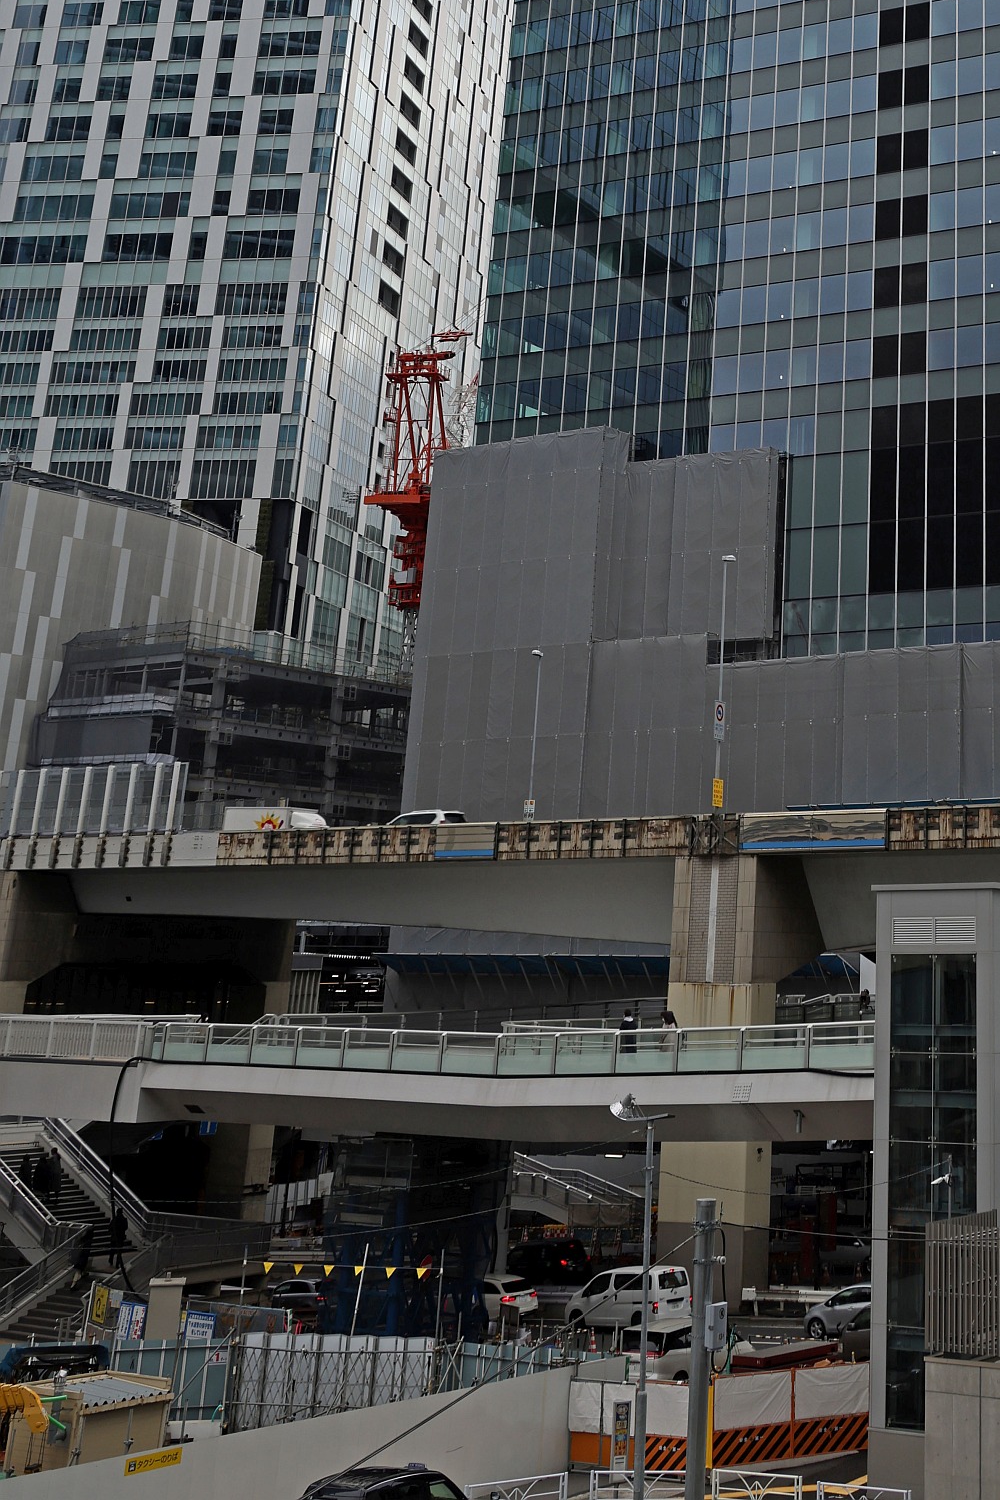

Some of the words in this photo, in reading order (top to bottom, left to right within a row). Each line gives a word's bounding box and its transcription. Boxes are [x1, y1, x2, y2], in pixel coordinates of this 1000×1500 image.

[137, 1451, 179, 1470] タクシーのりば
